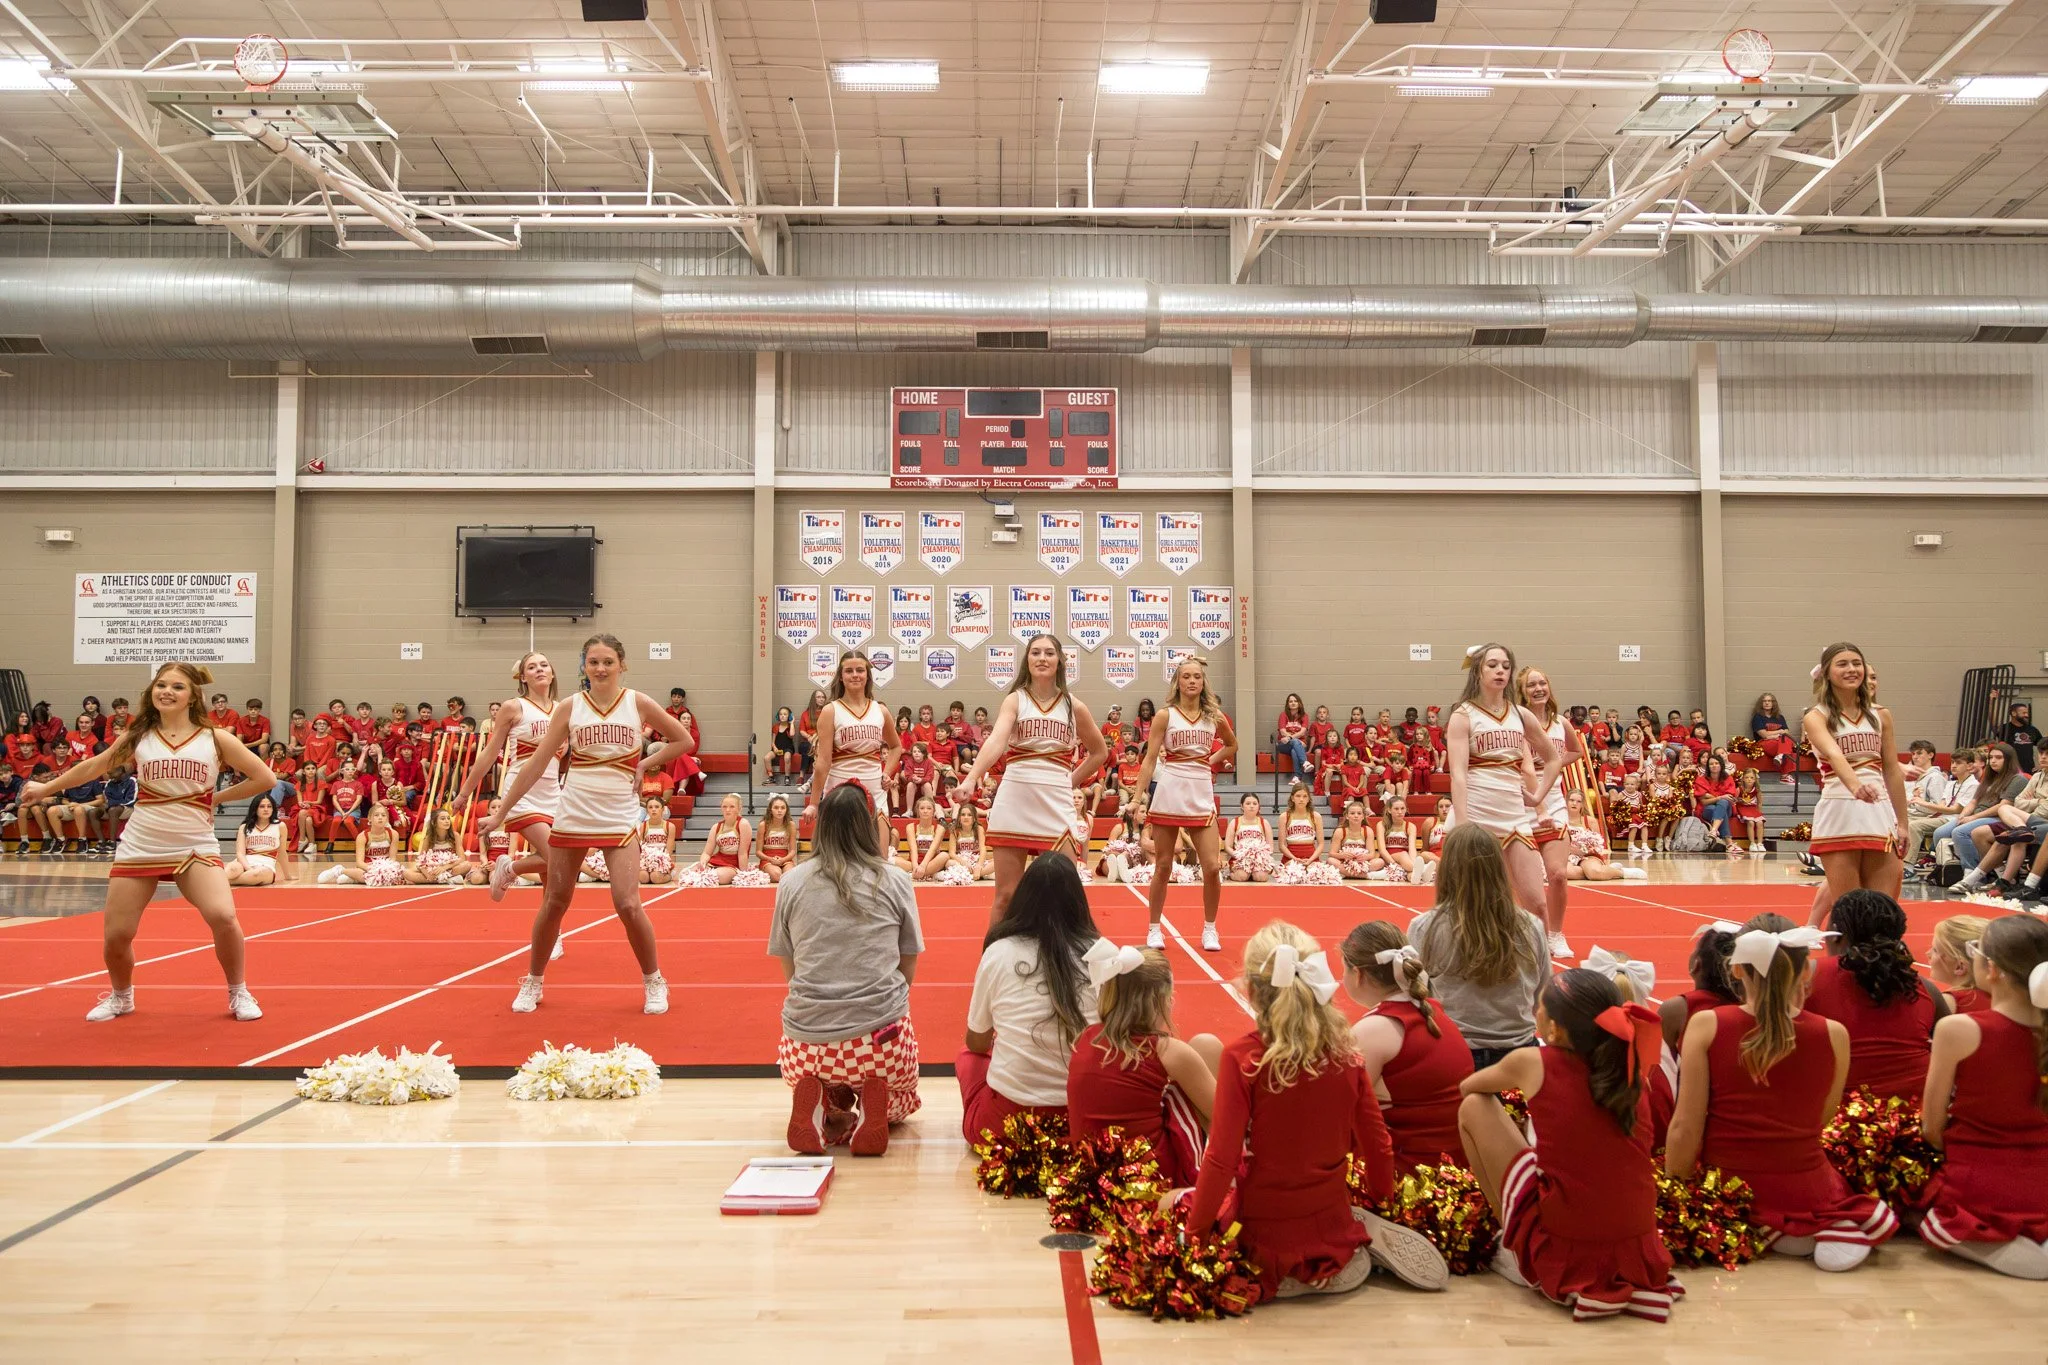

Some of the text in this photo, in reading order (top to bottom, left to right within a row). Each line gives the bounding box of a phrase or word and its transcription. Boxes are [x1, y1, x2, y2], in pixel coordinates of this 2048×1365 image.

[901, 392, 938, 404] HOME
[1068, 392, 1109, 405] GUEST
[1087, 466, 1108, 474] SCORE
[895, 479, 941, 487] Scoreboard
[944, 479, 979, 487] Donated
[981, 479, 991, 488] by
[994, 479, 1021, 487] Electra
[1024, 479, 1077, 487] Construction
[864, 538, 901, 546] VOLLEYBALL
[923, 538, 960, 546] VOLLEYBALL
[1041, 538, 1079, 546] VOLLEYBALL
[1101, 539, 1139, 547] BASKETBALL
[804, 546, 842, 554] CHAMPIONS
[864, 546, 901, 554] CHAMPION
[923, 546, 960, 554] CHAMPION
[1041, 546, 1079, 554] CHAMPION
[1101, 547, 1139, 555] RUNNERUP
[1160, 546, 1198, 554] CHAMPION
[813, 556, 833, 565] 2018
[101, 575, 232, 586] ATHLETICS CODE OF CONDUCT
[778, 612, 816, 620] VOLLEYBALL
[833, 612, 871, 620] BASKETBALL
[892, 612, 930, 620] BASKETBALL
[1012, 612, 1050, 620] TENNIS
[1131, 613, 1168, 621] VOLLEYBALL
[758, 596, 768, 657] WARRIORS
[778, 620, 816, 628] CHAMPION
[833, 620, 871, 629] CHAMPIONS
[892, 620, 931, 629] CHAMPIONS
[1012, 620, 1050, 628] CHAMPION
[1071, 621, 1109, 629] CHAMPION
[1130, 621, 1168, 629] CHAMPION
[1192, 621, 1230, 630] CHAMPION
[1239, 597, 1249, 657] WARRIORS
[951, 626, 989, 634] CHAMPION
[1017, 719, 1071, 744] WARRIORS
[576, 725, 634, 747] WARRIORS
[143, 759, 209, 783] WARRIORS
[1287, 825, 1314, 835] WARRIORS
[245, 835, 276, 847] WARRIORS
